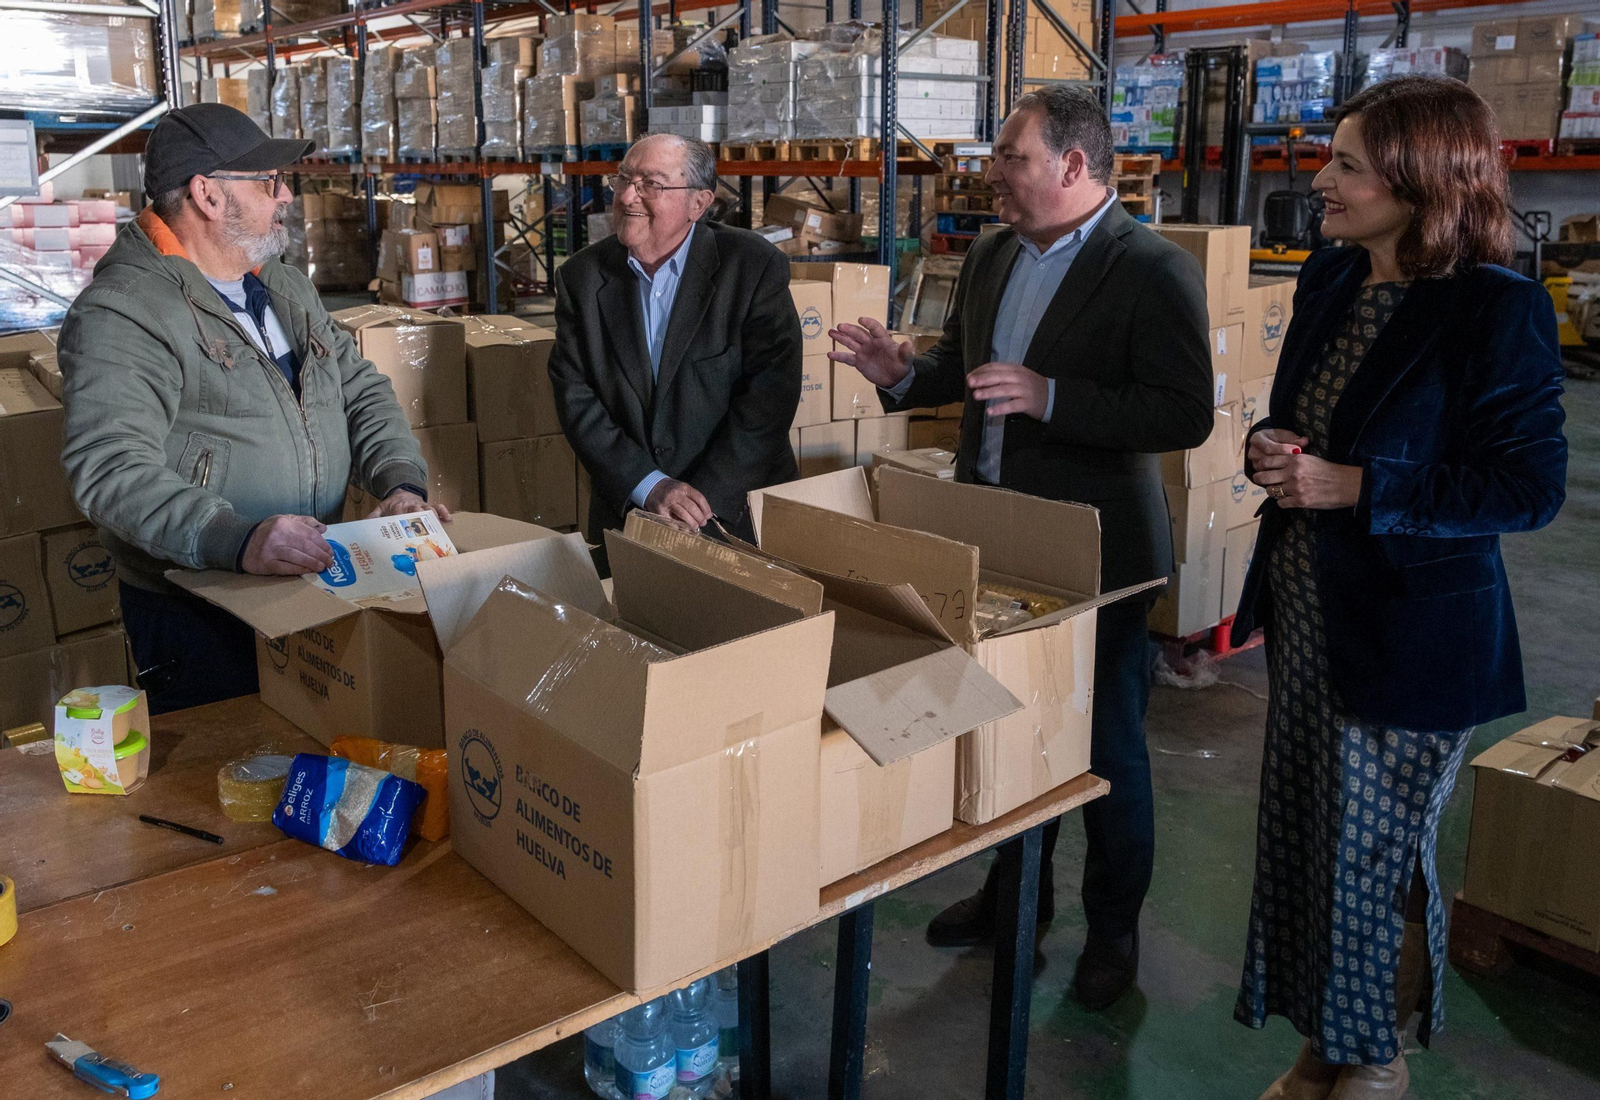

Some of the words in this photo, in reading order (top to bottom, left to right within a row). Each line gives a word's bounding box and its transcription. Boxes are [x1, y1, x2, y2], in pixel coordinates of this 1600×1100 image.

[417, 284, 464, 296] CAMACHO
[350, 542, 371, 571] CEREALES
[324, 635, 335, 654] DE
[297, 645, 342, 683] ALIMENTOS
[343, 671, 355, 690] DE
[299, 669, 329, 700] HUELVA
[288, 771, 306, 804] eliges
[300, 788, 313, 823] ARROZ
[563, 795, 581, 823] DE
[516, 798, 590, 863] ALIMENTOS
[593, 850, 613, 879] DE
[516, 828, 566, 881] HUELVA
